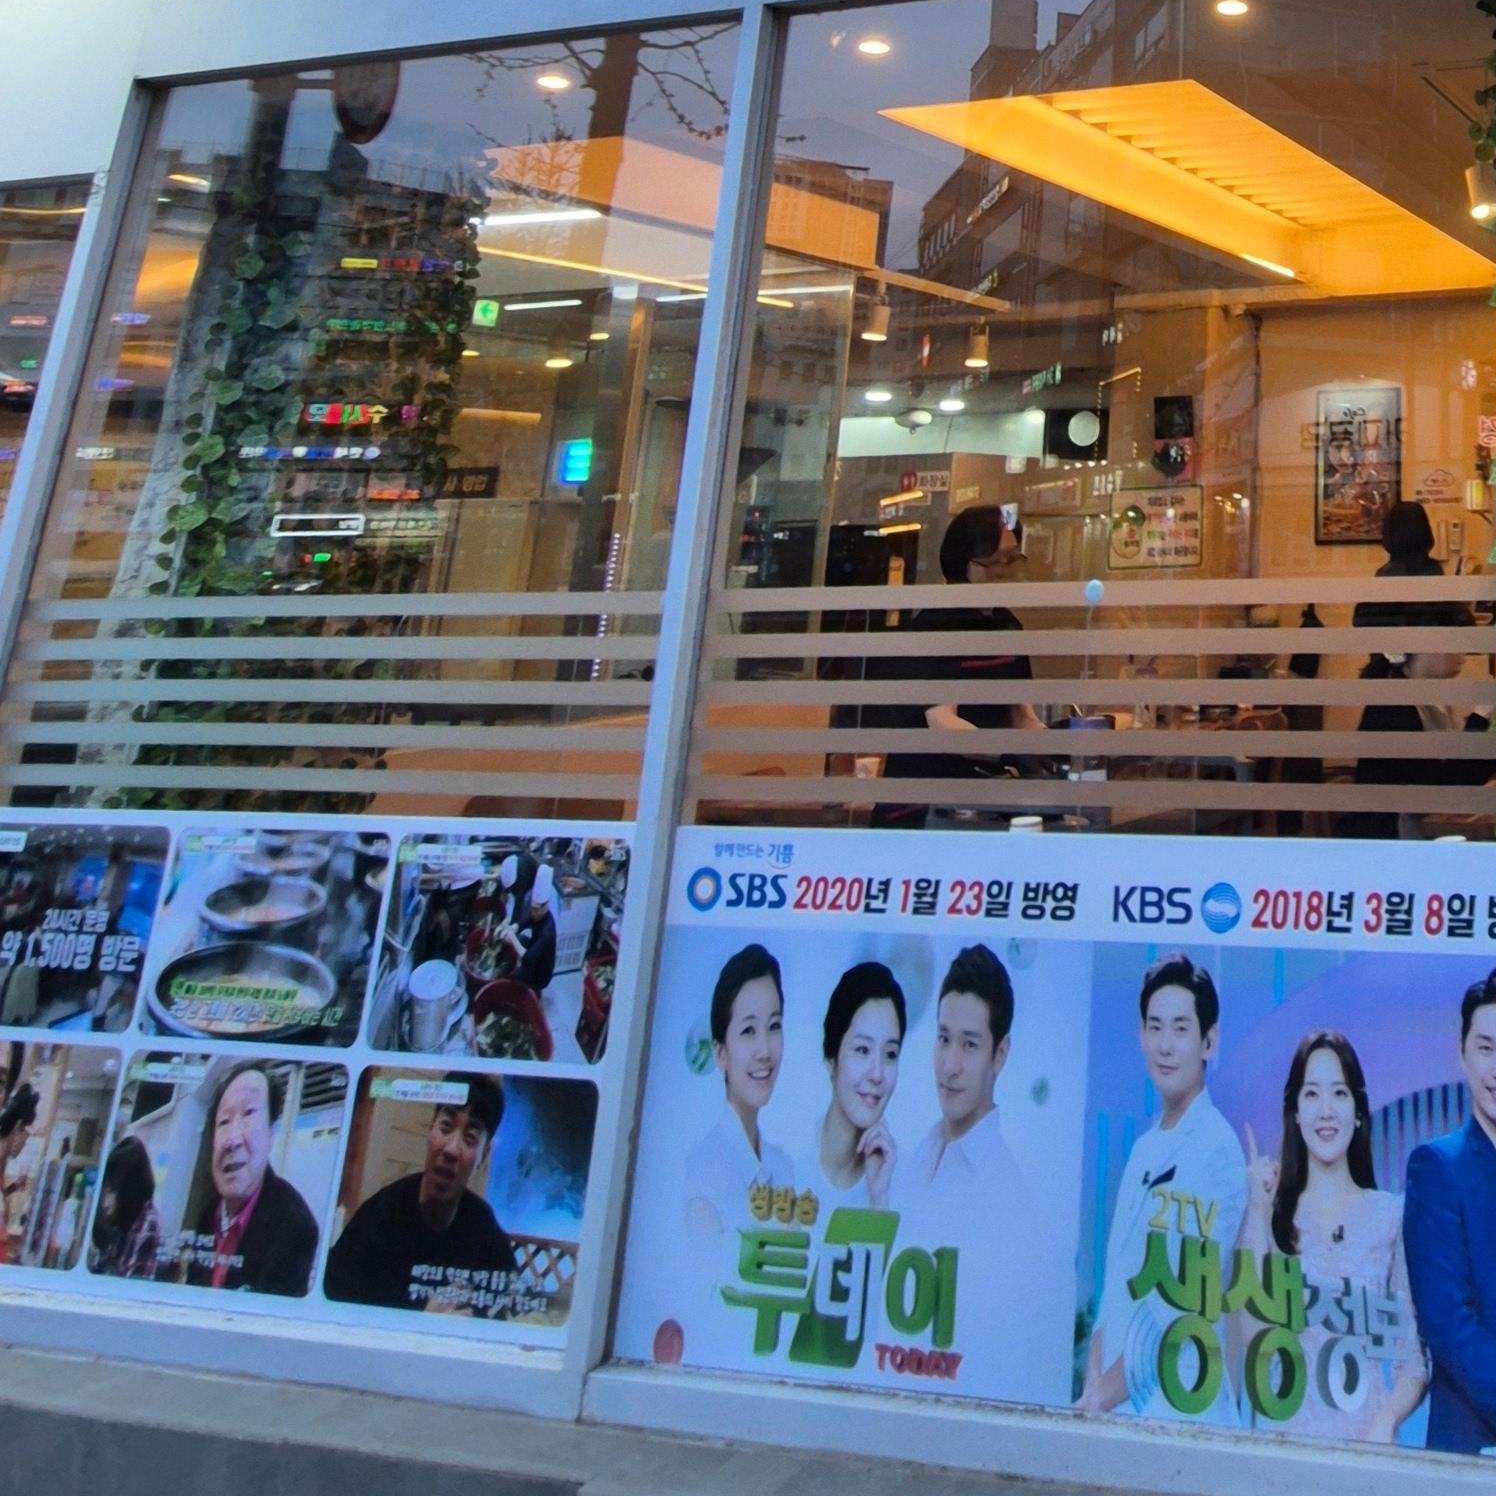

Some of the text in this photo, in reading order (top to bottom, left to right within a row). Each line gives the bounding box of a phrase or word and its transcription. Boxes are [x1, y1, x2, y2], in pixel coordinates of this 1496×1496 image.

[726, 873, 789, 909] SBS
[793, 876, 1080, 922] 2020년 1월 23일 방영
[1112, 885, 1193, 925] KBS
[1251, 889, 1356, 934] 2018년
[1364, 891, 1416, 936] 3월
[1424, 893, 1477, 937] 8일
[99, 936, 141, 972] 방문
[748, 1180, 819, 1227] 생방송
[1148, 1187, 1218, 1238] 2TV
[720, 1212, 960, 1362] 투데이
[875, 1343, 964, 1381] TODAY
